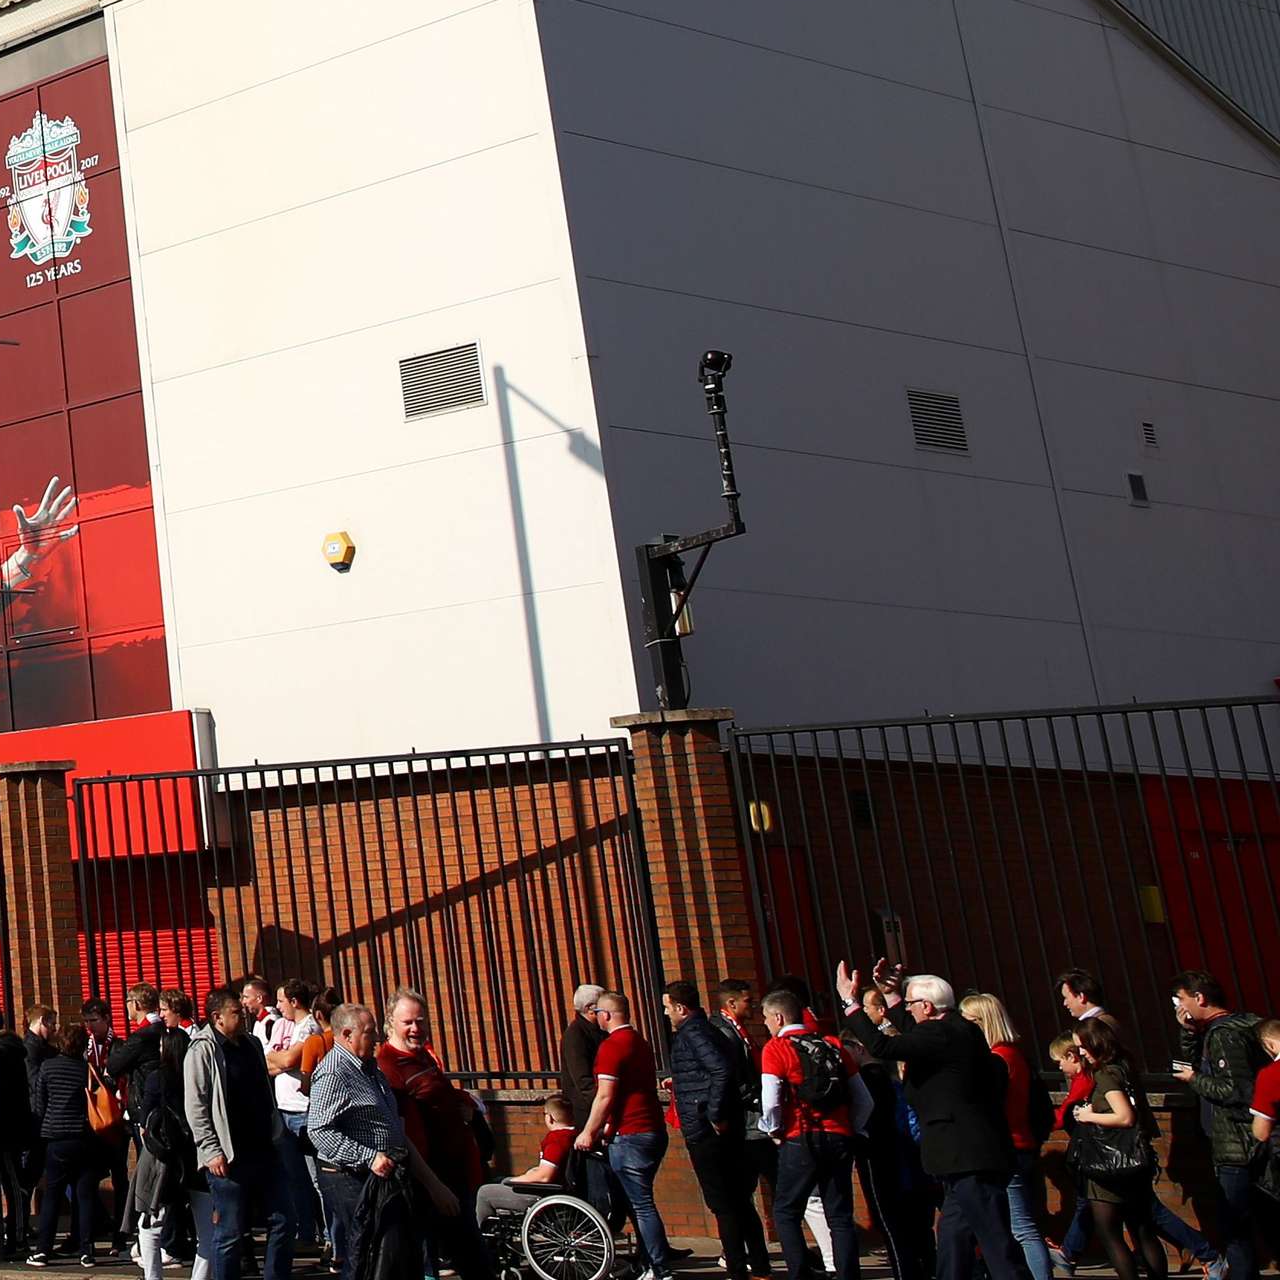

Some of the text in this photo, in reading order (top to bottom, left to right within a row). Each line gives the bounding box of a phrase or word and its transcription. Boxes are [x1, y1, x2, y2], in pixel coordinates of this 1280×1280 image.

[19, 160, 72, 189] LIVERPOOL
[80, 155, 98, 170] 2017
[26, 259, 82, 288] 125 YEARS
